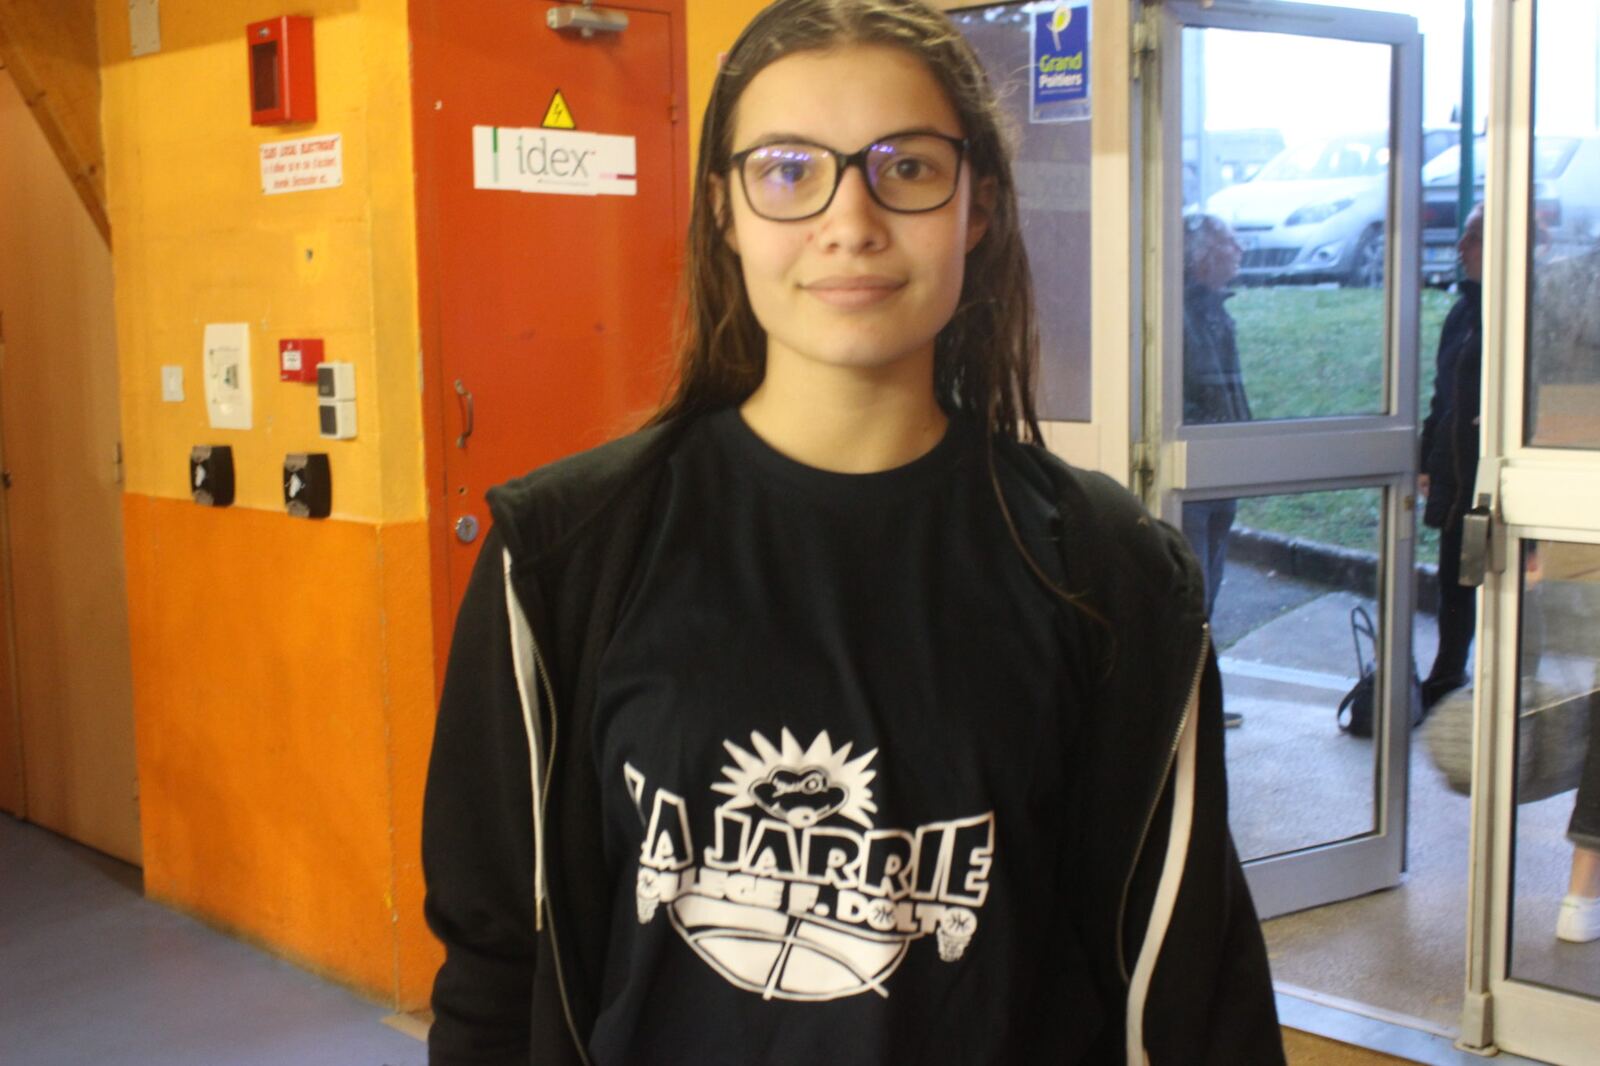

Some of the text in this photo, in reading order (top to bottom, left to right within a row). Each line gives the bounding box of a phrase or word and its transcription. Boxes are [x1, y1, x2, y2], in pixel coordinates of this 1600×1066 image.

[1039, 72, 1082, 89] Poitiers
[1040, 51, 1082, 73] Grand
[516, 136, 589, 178] idex
[703, 806, 995, 908] JARRIE
[836, 889, 978, 940] DOLTO
